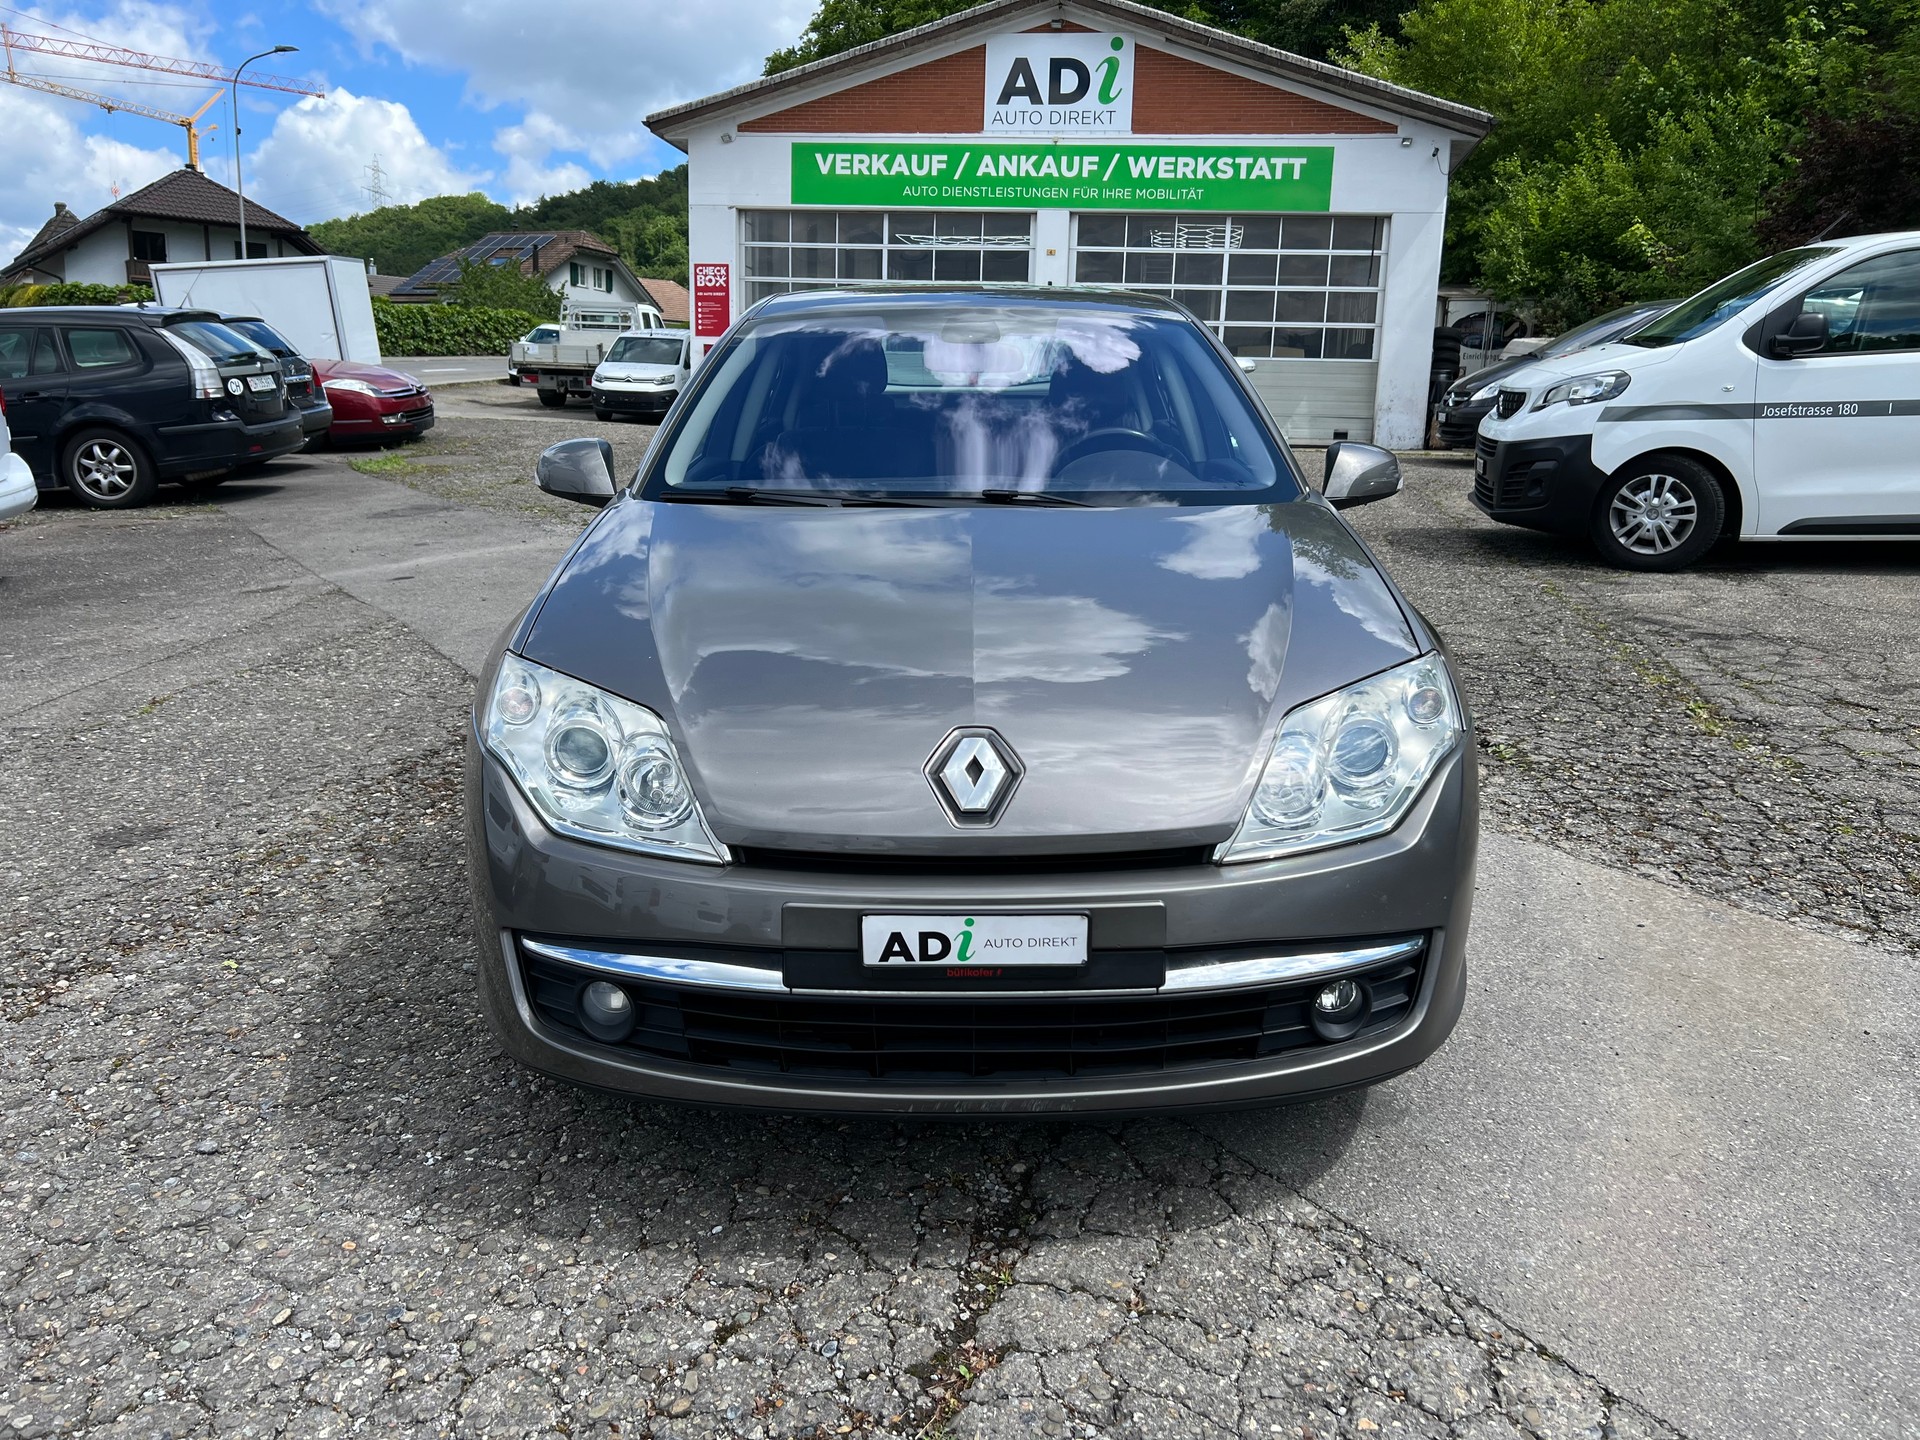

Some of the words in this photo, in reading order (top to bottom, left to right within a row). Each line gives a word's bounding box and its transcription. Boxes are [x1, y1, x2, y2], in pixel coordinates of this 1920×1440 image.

[992, 111, 1042, 125] AUTO
[1050, 111, 1116, 125] DIREKT
[815, 153, 947, 176] VERKAUF
[976, 154, 1099, 178] ANKAUF
[1127, 156, 1307, 180] WERKSTATT
[902, 185, 938, 197] AUTO
[942, 186, 1069, 199] DIENSTLEISTUNGEN
[1073, 186, 1099, 199] FÜR
[1102, 188, 1131, 200] IHRE
[1135, 187, 1204, 201] MOBILITÄT
[696, 266, 727, 275] CHECK
[696, 275, 727, 287] BOX
[230, 380, 241, 392] CH
[1762, 404, 1833, 417] Josefstrasse
[1837, 403, 1858, 415] 180
[983, 938, 1023, 949] AUTO
[1027, 937, 1078, 948] DIREKT
